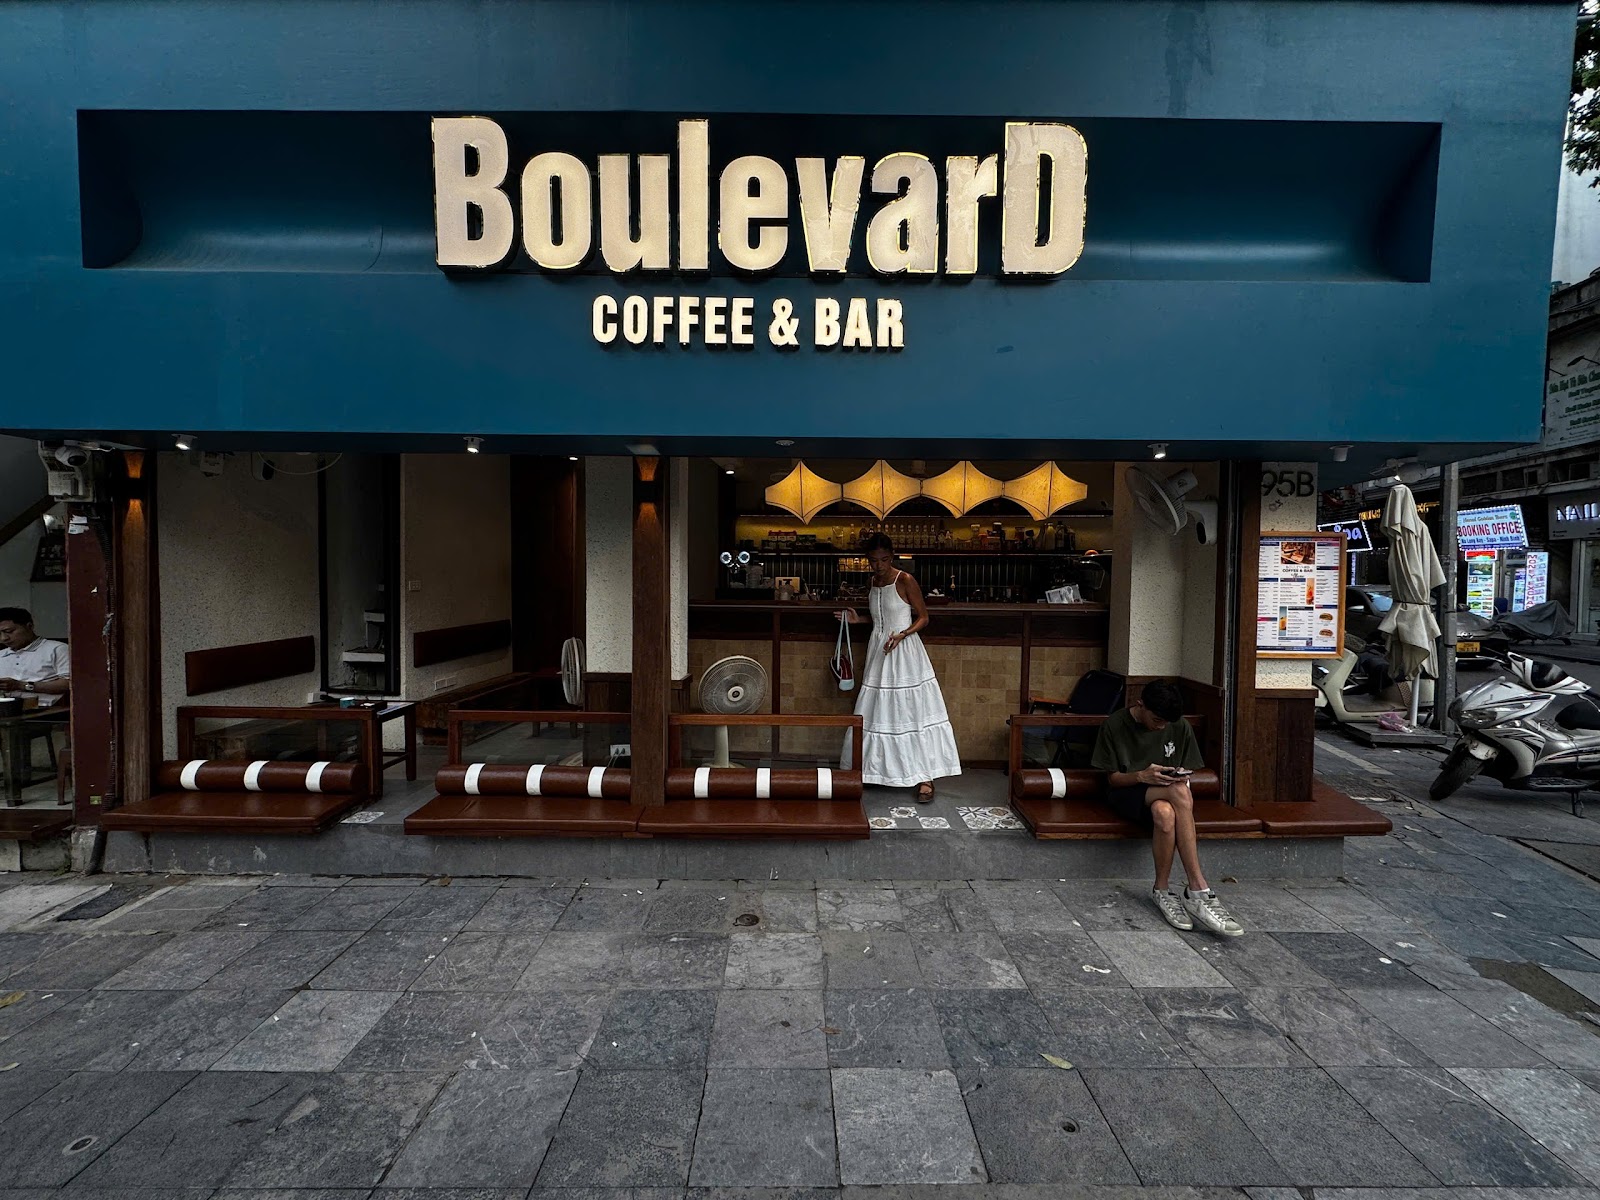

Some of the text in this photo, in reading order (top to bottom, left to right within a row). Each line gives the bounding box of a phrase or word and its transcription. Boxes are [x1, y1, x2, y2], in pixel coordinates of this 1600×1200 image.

[431, 115, 1089, 276] BoulevarD
[592, 294, 906, 349] COFFEE & BAR
[1261, 471, 1315, 497] 95B
[1457, 522, 1520, 537] BOOKING OFFICE
